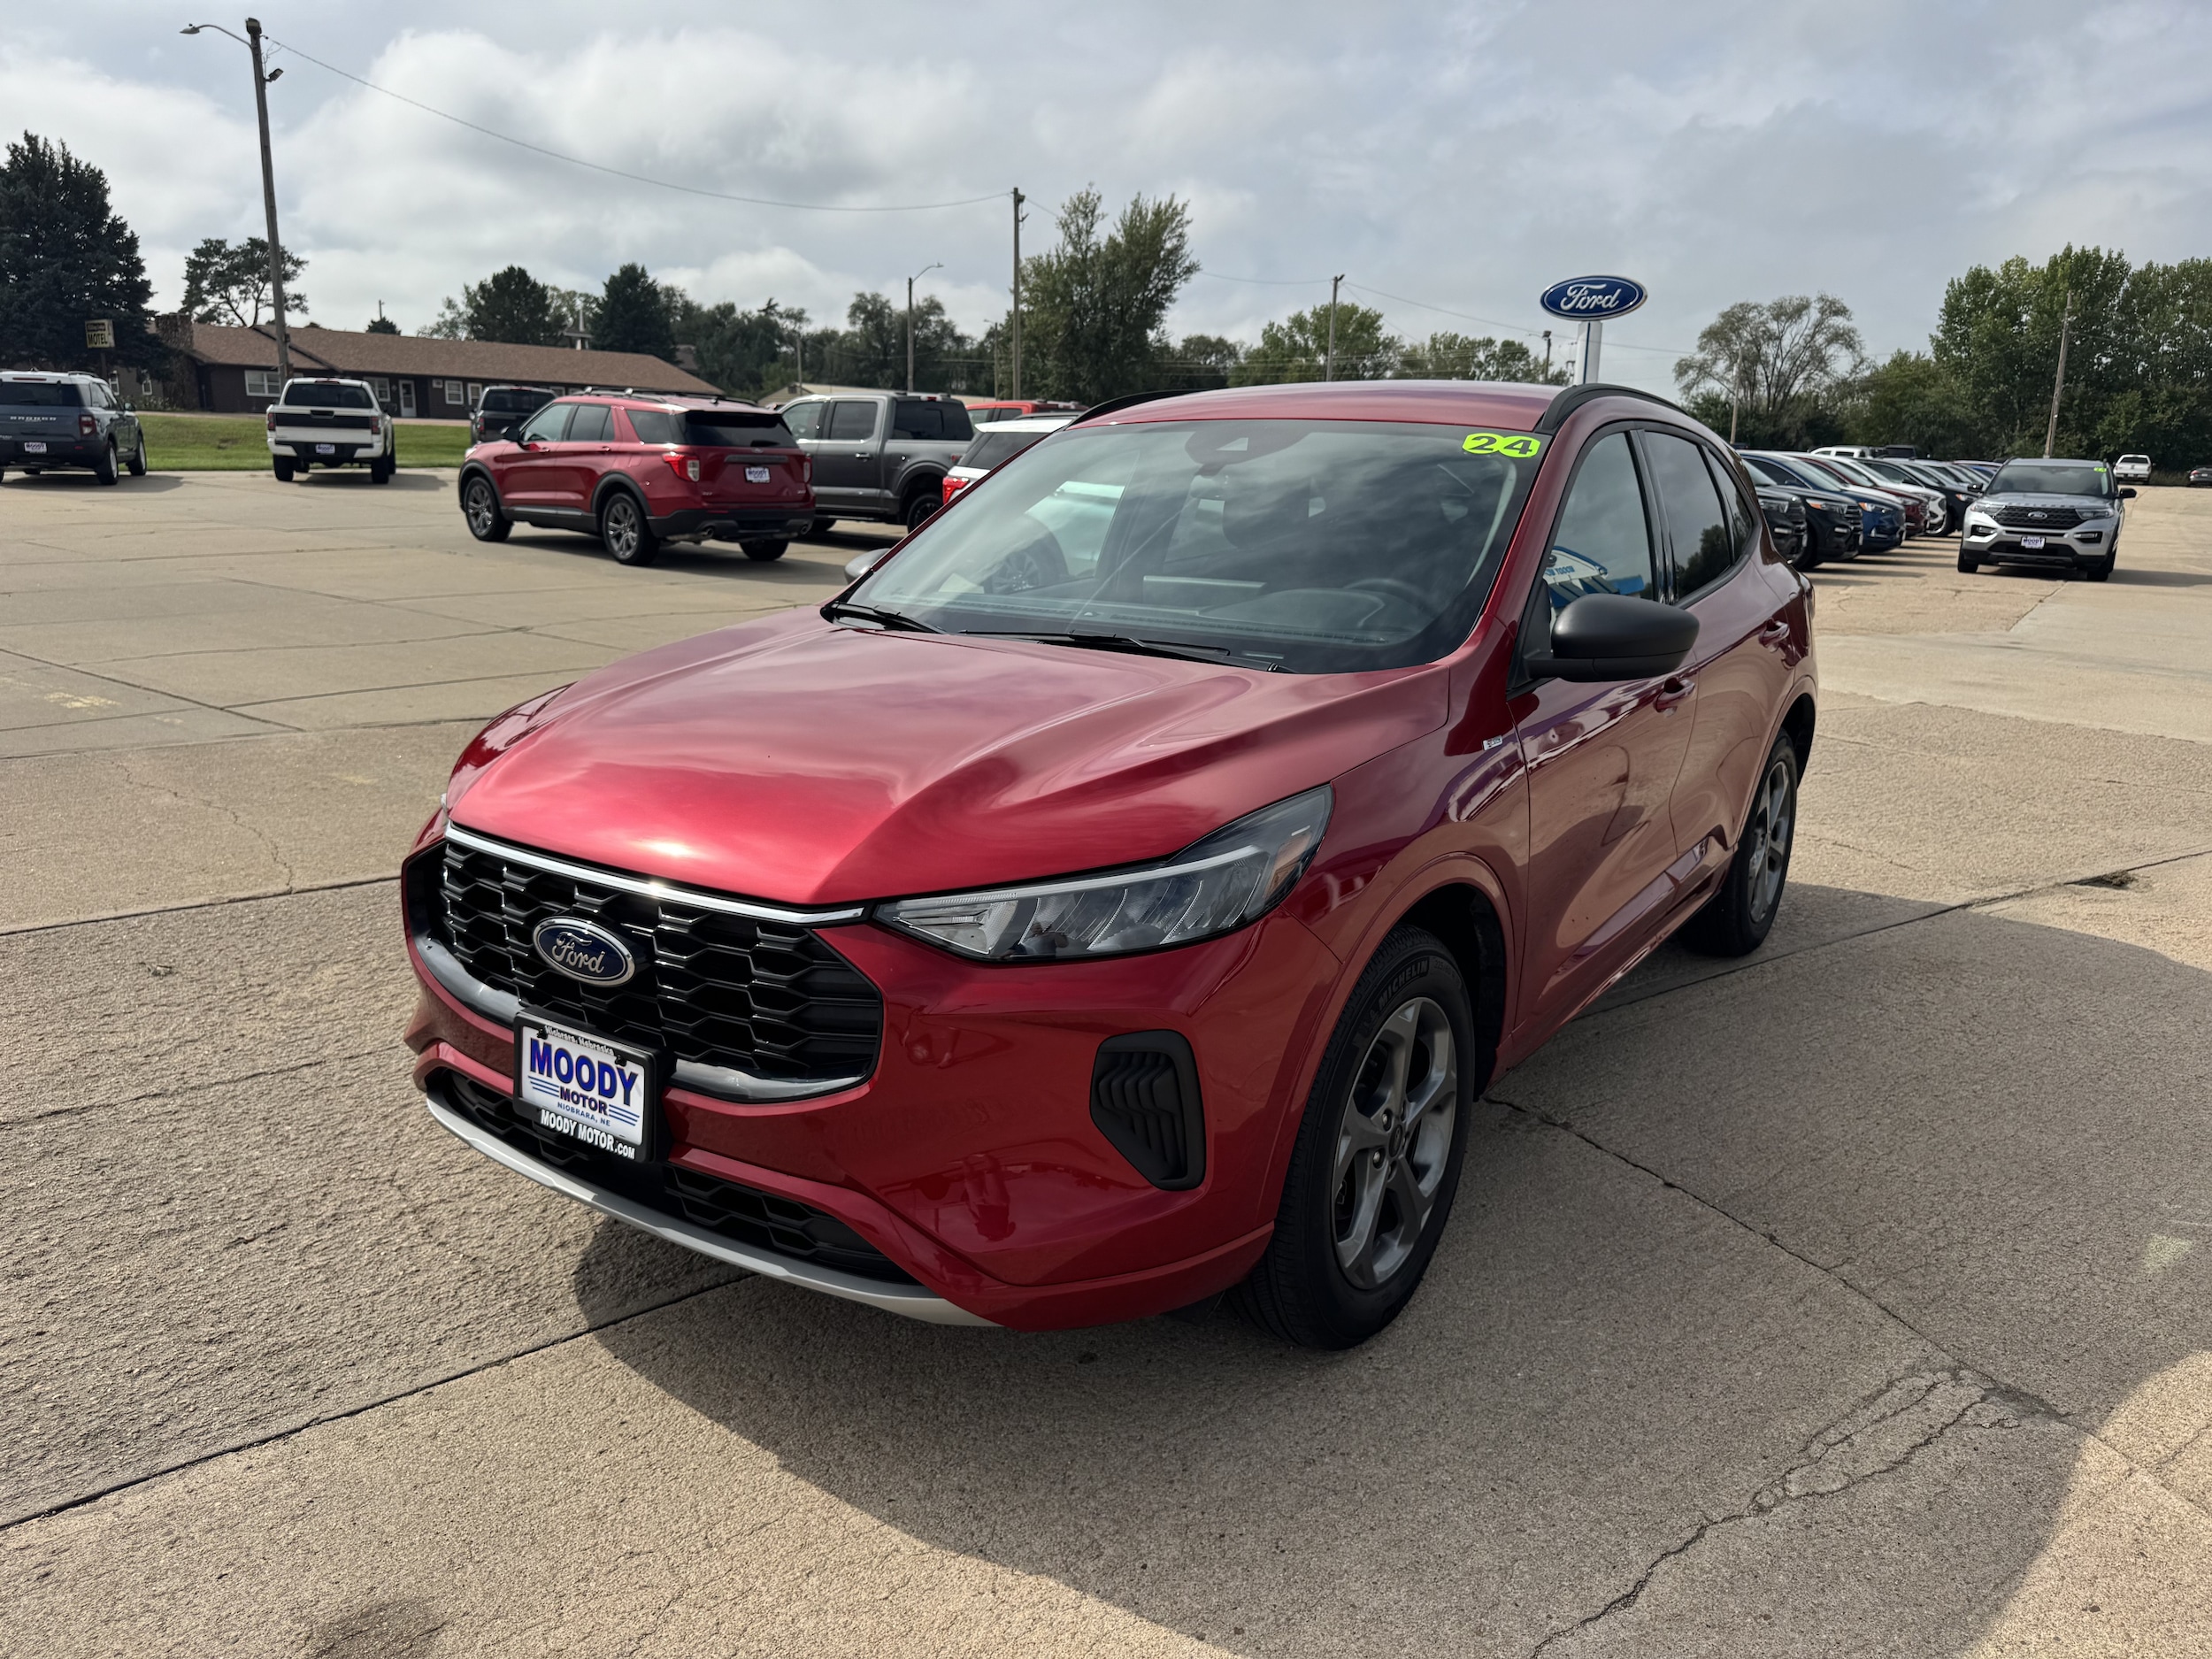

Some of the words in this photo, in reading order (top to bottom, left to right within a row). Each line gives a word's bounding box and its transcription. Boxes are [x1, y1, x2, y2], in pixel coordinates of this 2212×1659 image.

[1560, 283, 1622, 311] Ford
[88, 333, 108, 345] MOTEL
[1468, 435, 1533, 455] 24
[551, 932, 606, 974] Ford
[1379, 960, 1428, 1010] MICHELIN
[544, 1025, 578, 1044] Niobrara,
[578, 1036, 615, 1056] Nebraska
[530, 1037, 639, 1107] MOODY
[557, 1101, 598, 1124] NIOBRARA,
[600, 1118, 611, 1127] NE
[559, 1086, 609, 1117] MOTOR
[540, 1109, 578, 1137] MOODY
